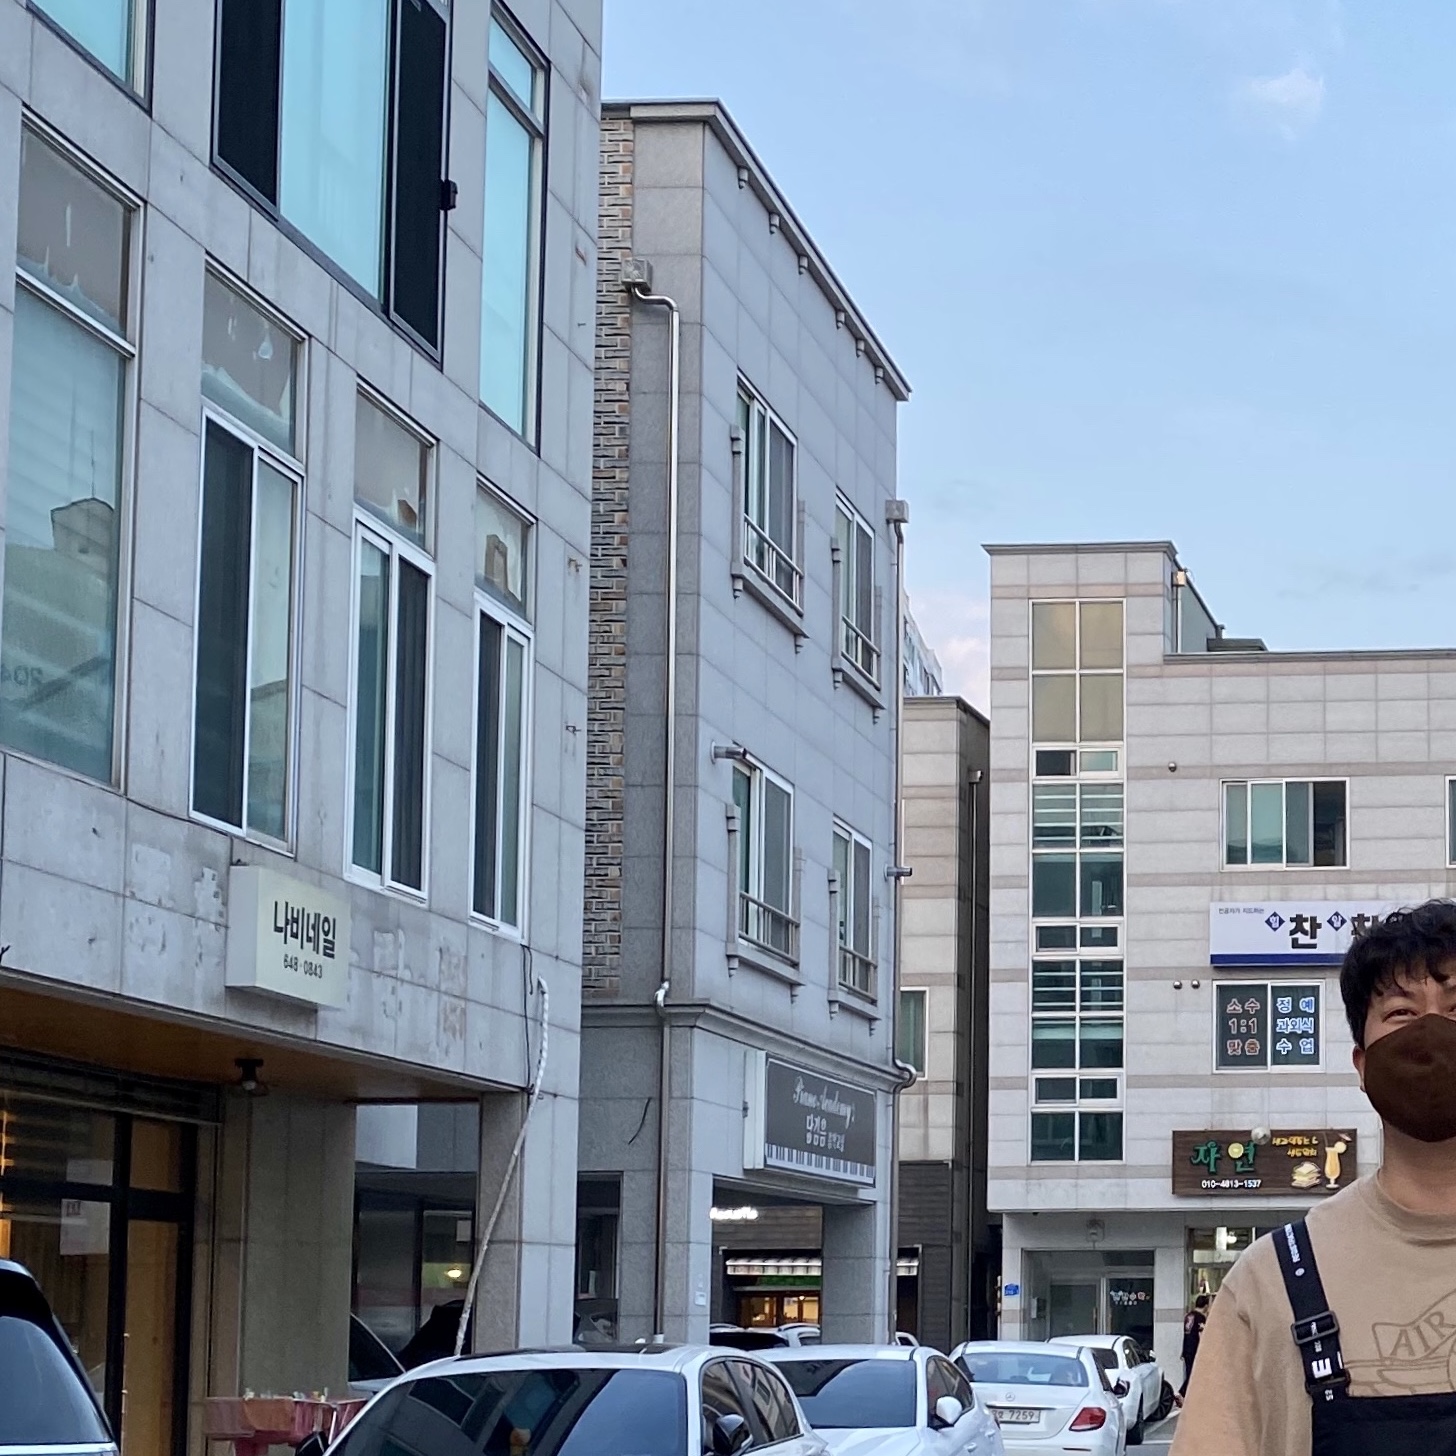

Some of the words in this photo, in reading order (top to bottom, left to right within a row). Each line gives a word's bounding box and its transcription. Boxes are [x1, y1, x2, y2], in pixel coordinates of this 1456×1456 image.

[274, 901, 336, 959] 나비네일
[1226, 998, 1260, 1014] 소수
[1228, 1017, 1257, 1034] 1:1
[1276, 1017, 1315, 1033] 과외식
[1390, 1311, 1456, 1357] AIR
[1008, 1408, 1035, 1421] 7259
